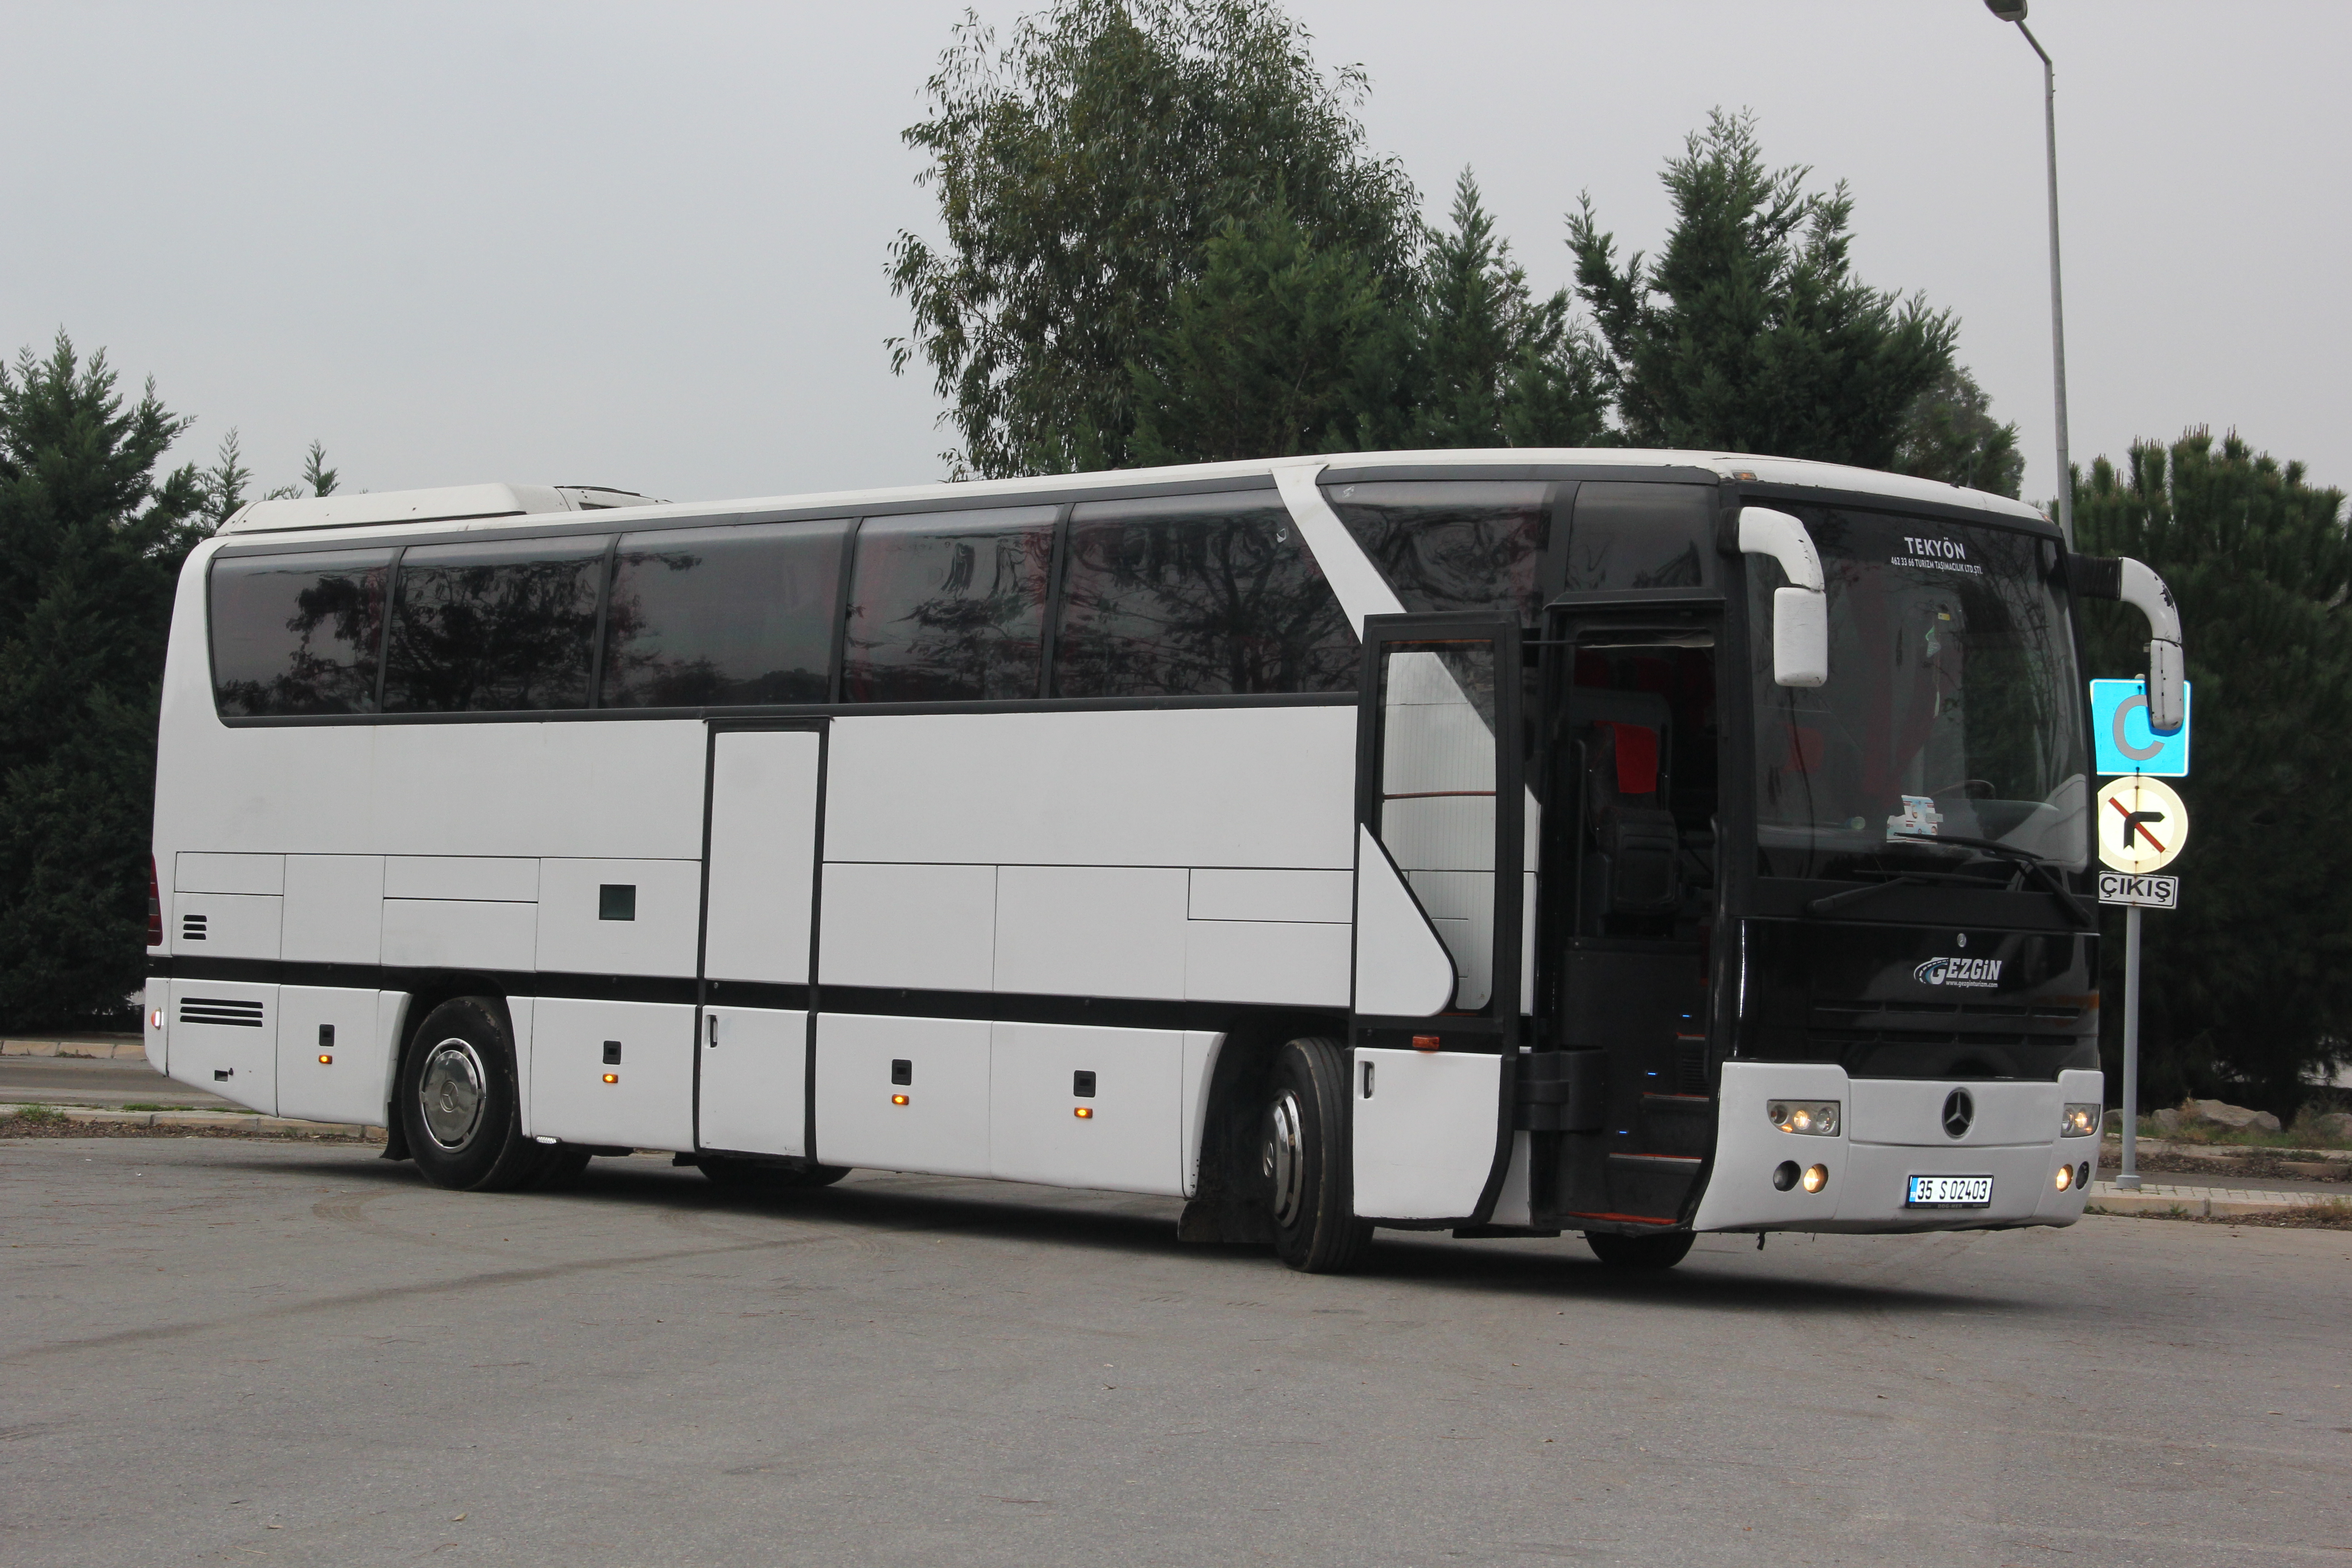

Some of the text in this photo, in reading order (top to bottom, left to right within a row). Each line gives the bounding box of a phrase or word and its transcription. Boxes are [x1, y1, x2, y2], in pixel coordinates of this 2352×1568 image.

[1904, 537, 1965, 560] TEKYÖN
[1891, 557, 1900, 565] 462
[1901, 558, 1907, 566] 33
[1908, 559, 1915, 567] 66
[1915, 558, 1934, 568] TURİZM
[1935, 561, 1964, 572] TAŞIMACILIK
[2100, 876, 2171, 902] ÇIKIŞ
[1917, 1181, 1987, 1200] 35 S 02403
